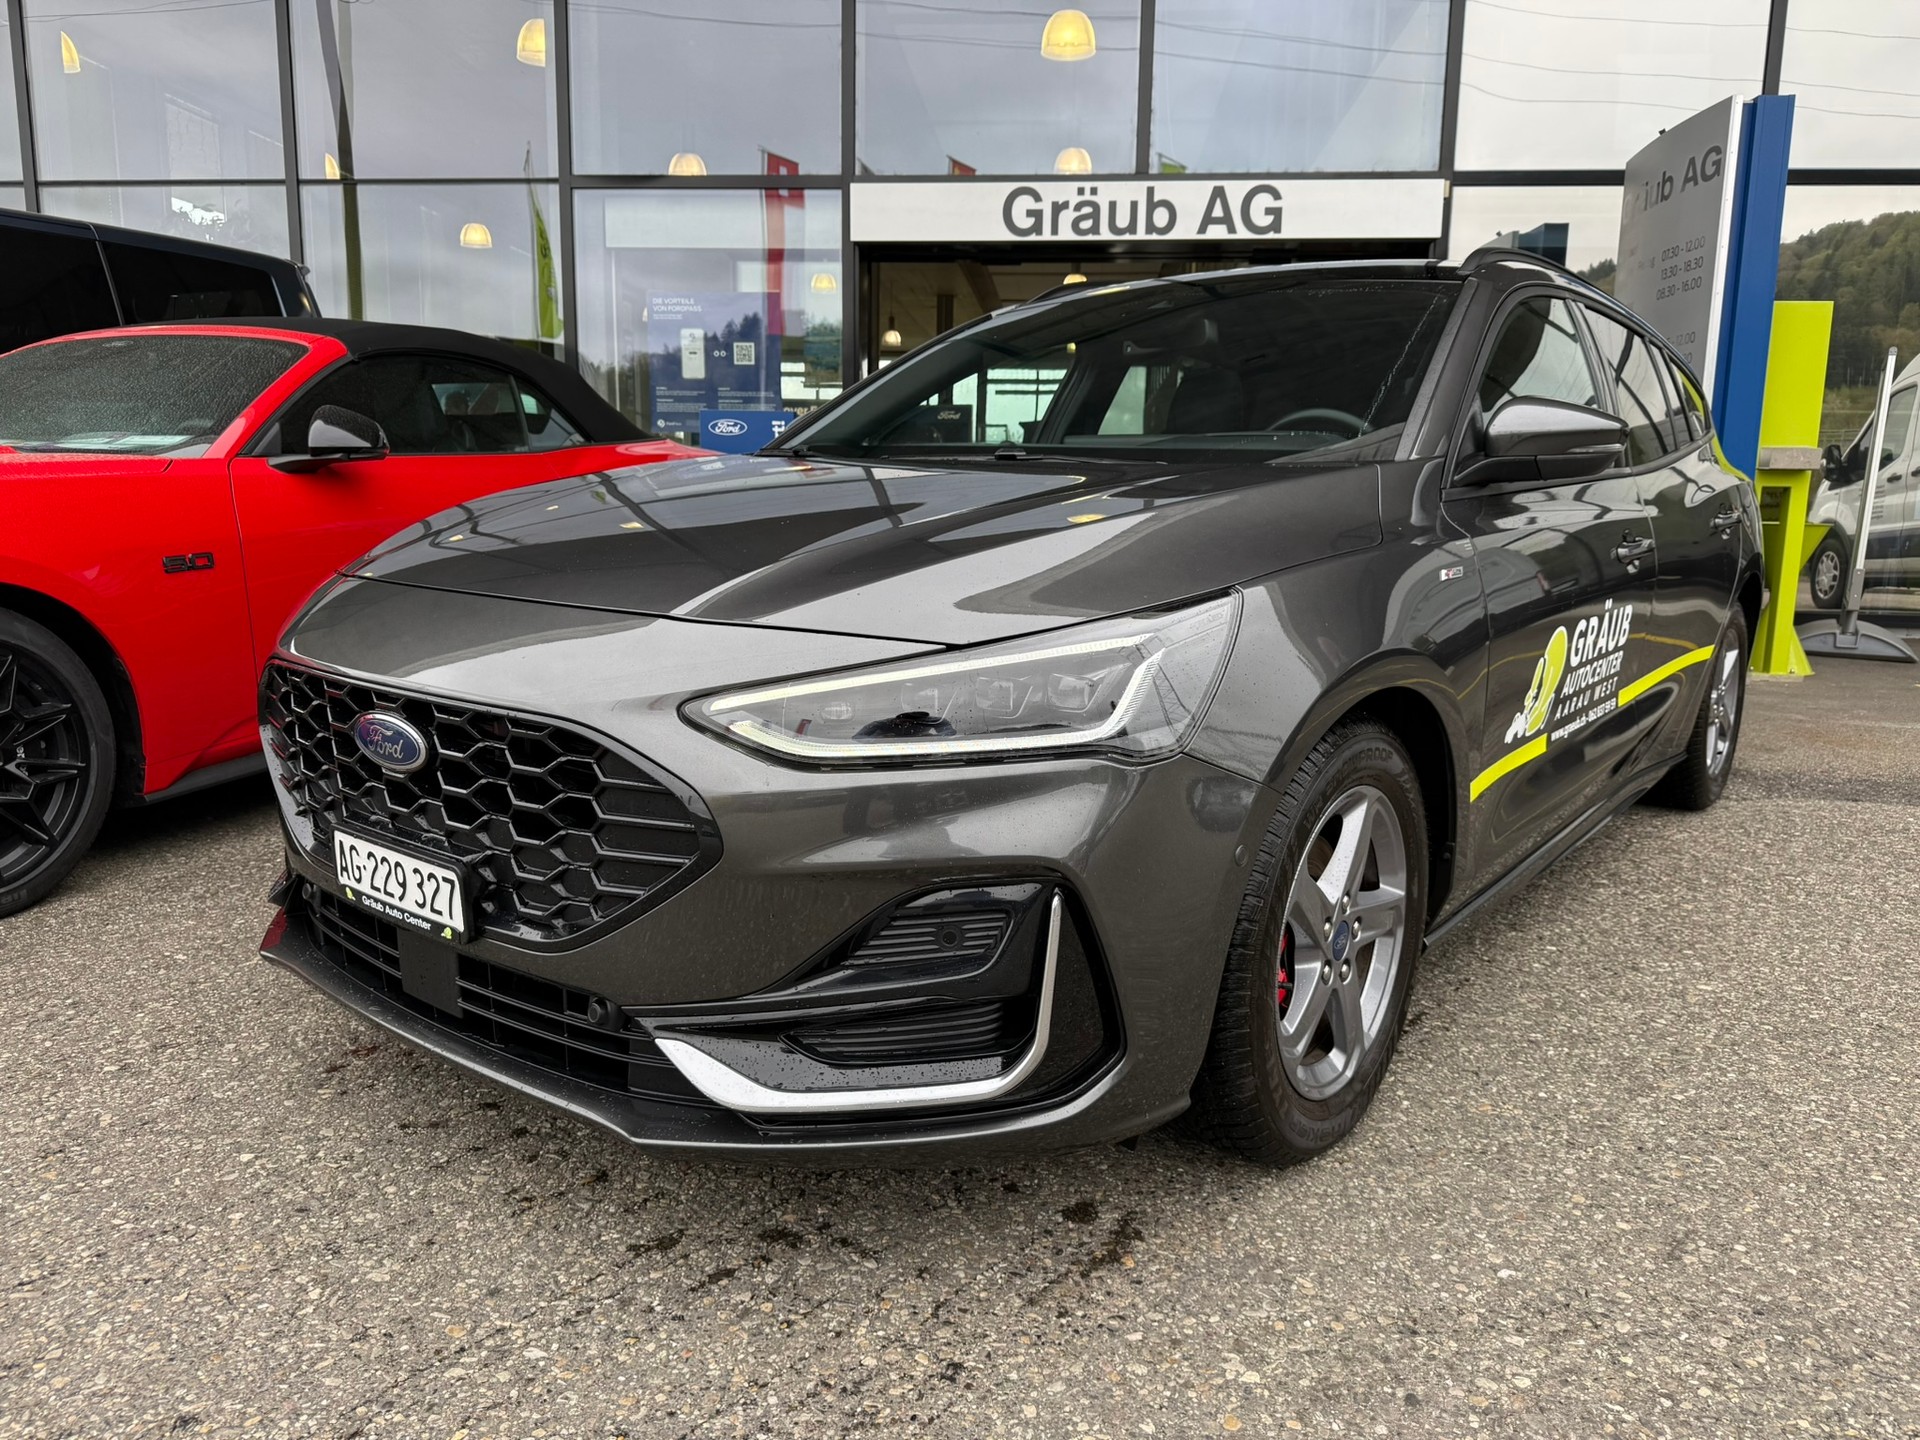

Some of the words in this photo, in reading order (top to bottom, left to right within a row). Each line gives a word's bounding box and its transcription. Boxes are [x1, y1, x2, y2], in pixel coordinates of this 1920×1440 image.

[1680, 144, 1722, 193] AG
[1002, 186, 1177, 237] Gräub
[1197, 184, 1283, 235] AG
[714, 421, 741, 434] Ford
[937, 410, 961, 420] Ford
[163, 552, 215, 574] 5.0
[1570, 597, 1633, 667] GRÄUB
[1560, 650, 1624, 698] AUTOCENTER
[1554, 689, 1591, 721] AARAU
[1594, 677, 1618, 701] WEST
[367, 725, 404, 759] Ford
[362, 896, 384, 912] Gräub
[385, 905, 403, 919] Auto
[404, 913, 432, 930] Center
[412, 867, 456, 920] 327
